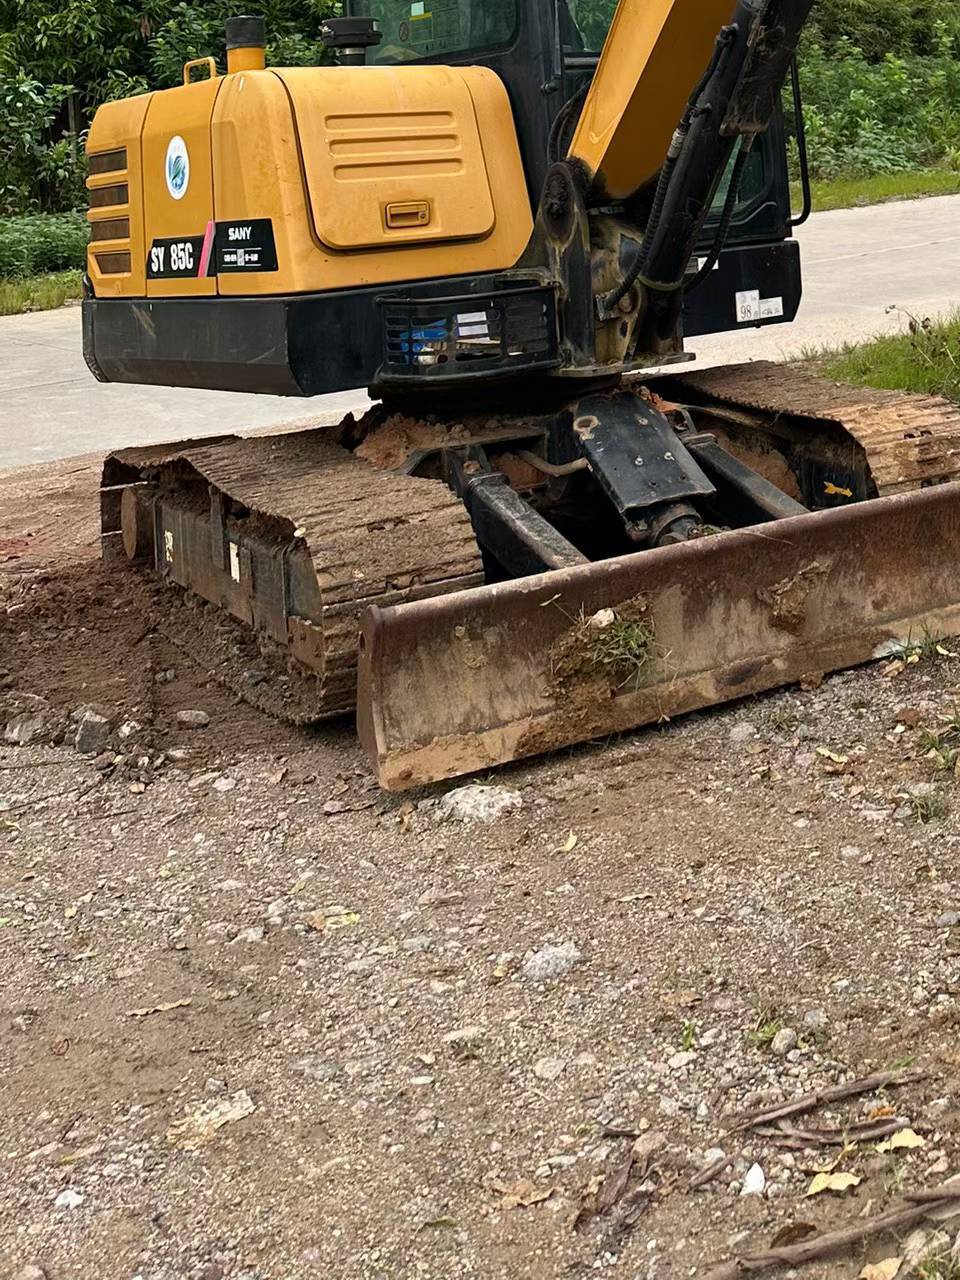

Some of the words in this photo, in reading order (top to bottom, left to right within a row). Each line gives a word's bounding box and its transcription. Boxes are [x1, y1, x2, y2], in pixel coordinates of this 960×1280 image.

[228, 226, 251, 240] SANY
[151, 244, 164, 272] SY
[170, 242, 193, 270] 85C
